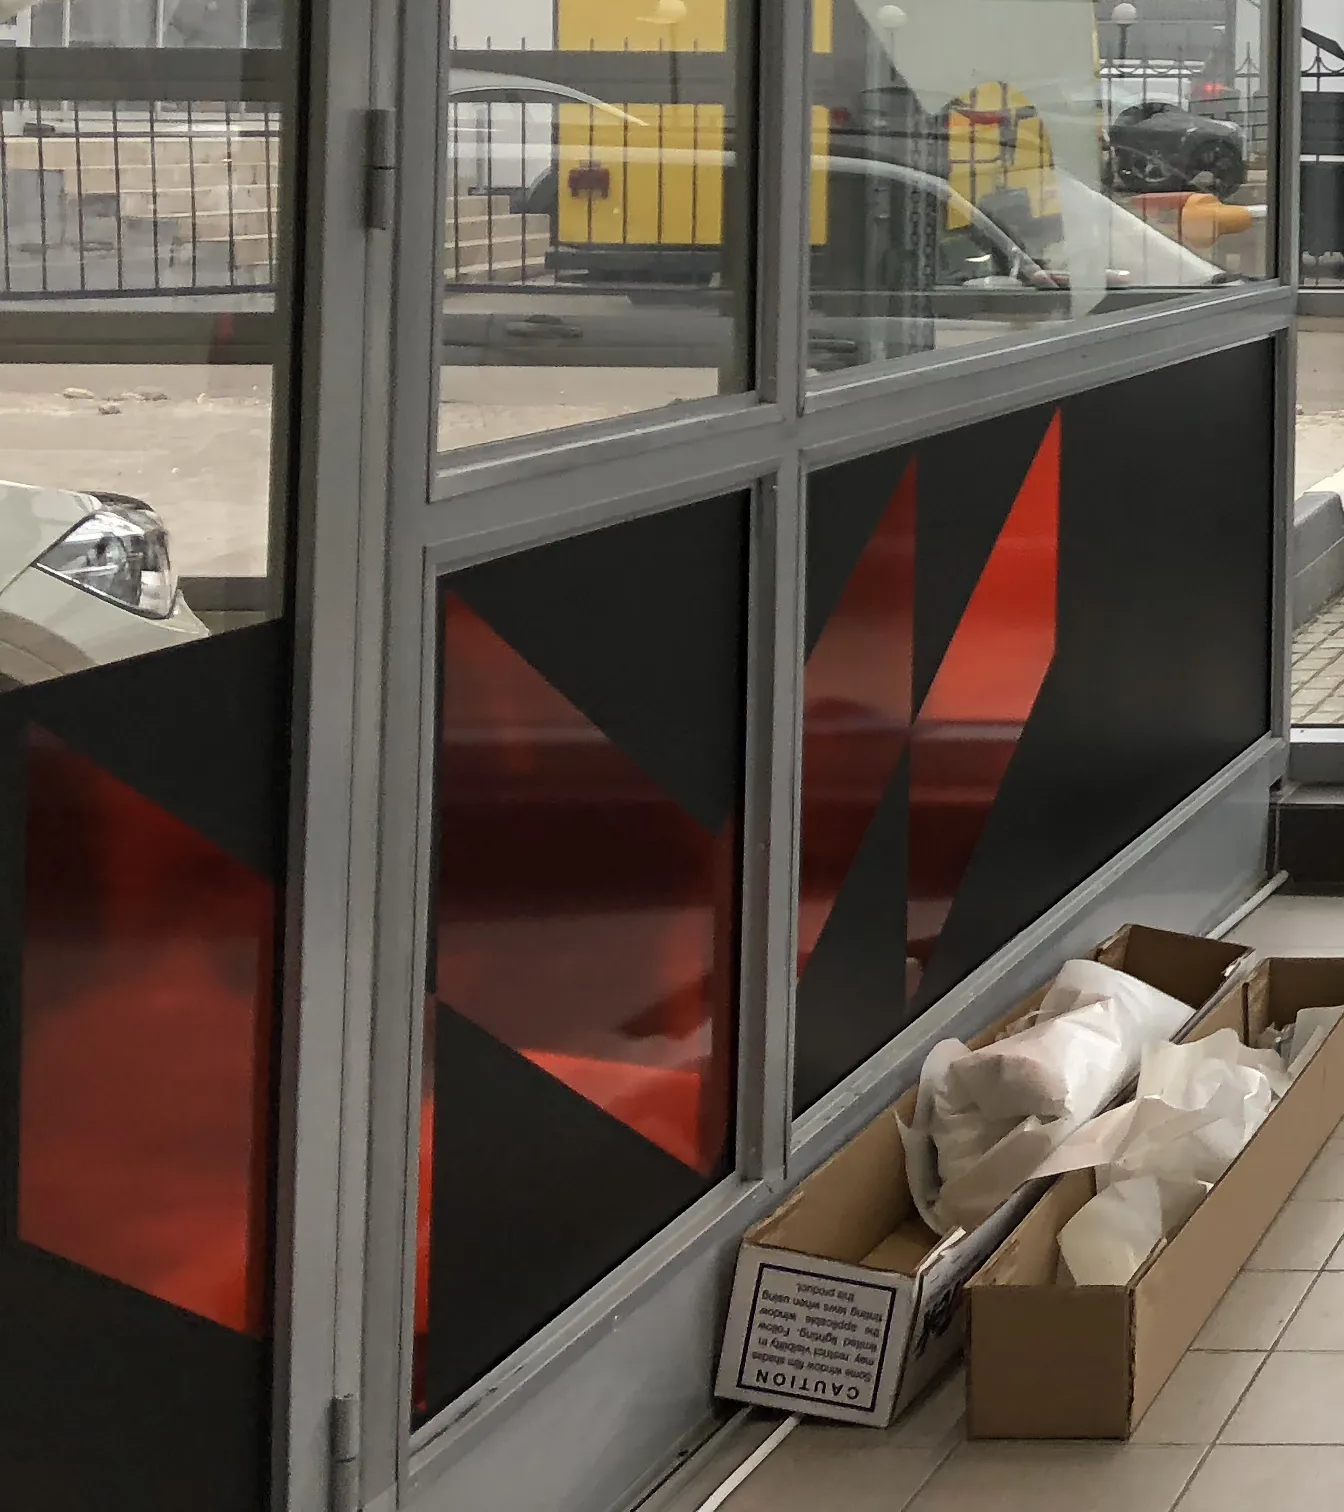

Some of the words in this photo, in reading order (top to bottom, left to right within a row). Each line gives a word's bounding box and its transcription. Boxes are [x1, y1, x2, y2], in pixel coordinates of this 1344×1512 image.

[762, 1289, 790, 1304] using
[837, 1290, 855, 1302] this
[793, 1297, 820, 1310] when
[823, 1303, 847, 1315] laws
[759, 1307, 797, 1322] window
[850, 1306, 882, 1323] tinting
[758, 1322, 790, 1337] Follow
[805, 1316, 858, 1332] applicable
[864, 1326, 880, 1338] the
[758, 1337, 767, 1346] in
[771, 1338, 811, 1354] visibility
[843, 1338, 877, 1352] limited
[814, 1348, 850, 1362] restrict
[854, 1353, 875, 1366] may
[788, 1358, 804, 1370] film
[807, 1362, 842, 1376] window
[845, 1368, 872, 1382] Some
[756, 1369, 859, 1399] CAUTION
